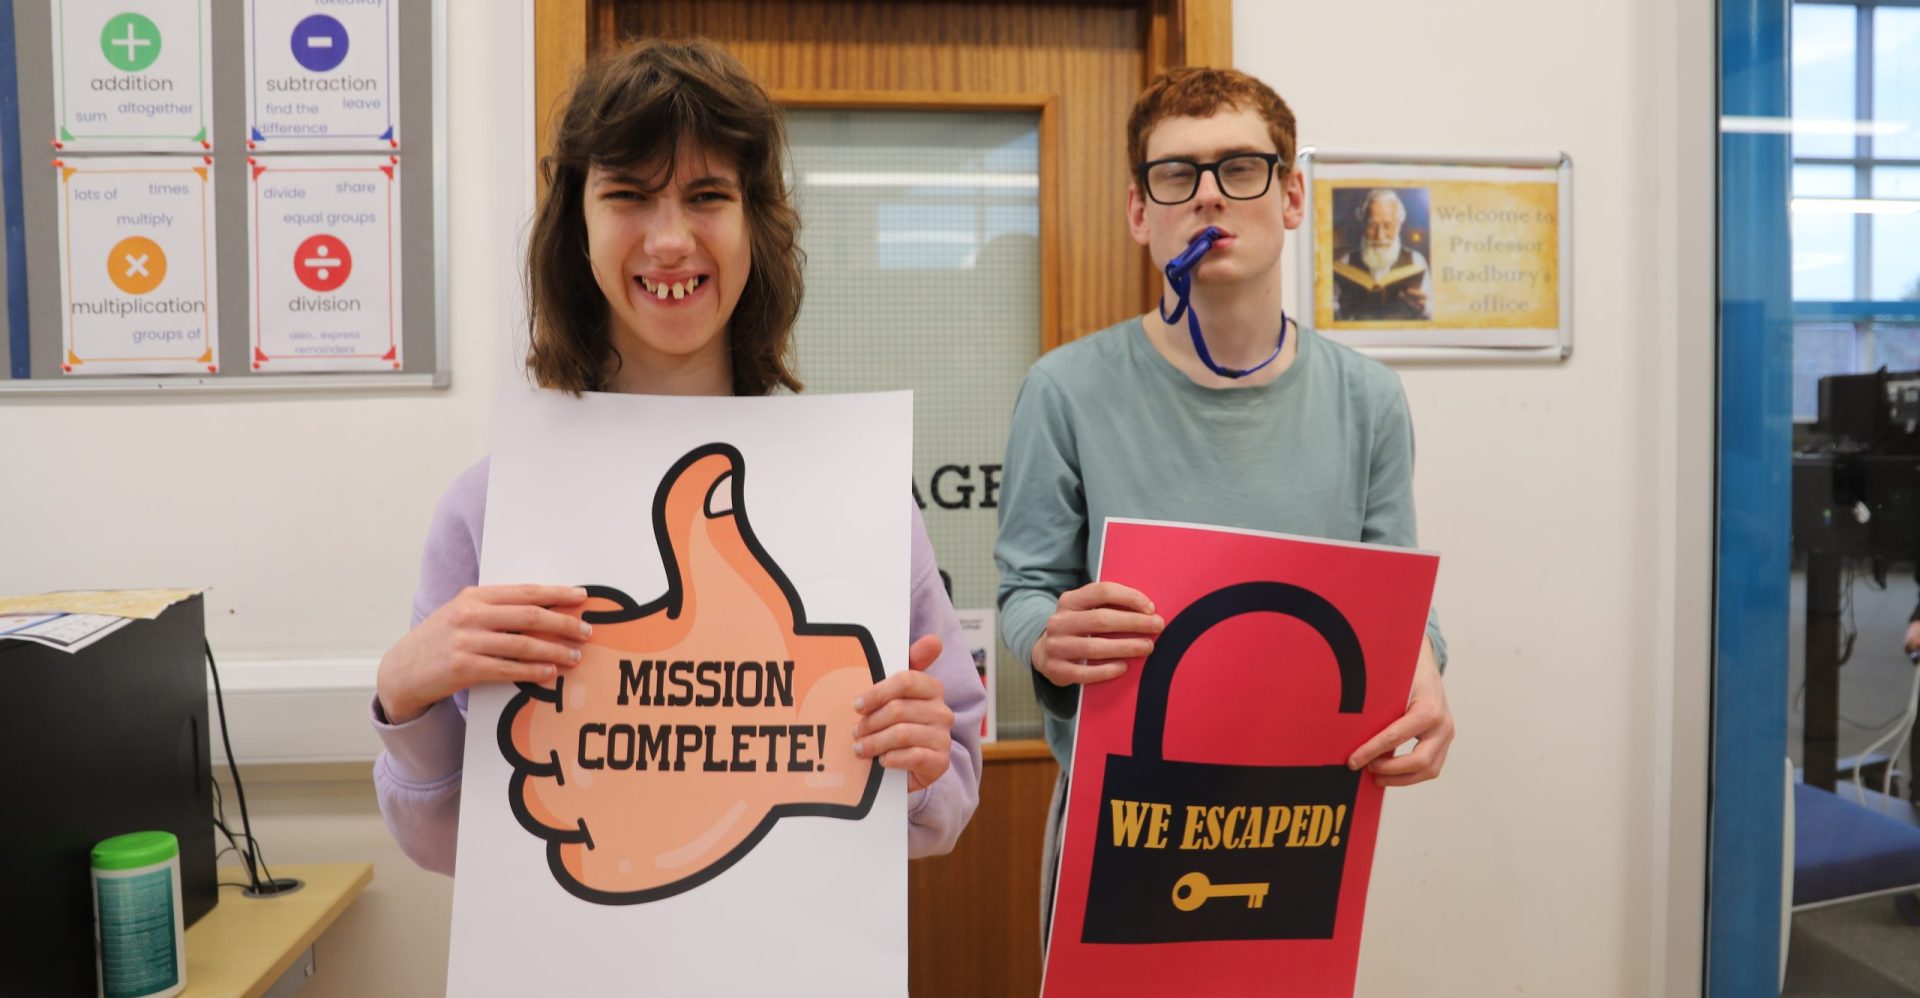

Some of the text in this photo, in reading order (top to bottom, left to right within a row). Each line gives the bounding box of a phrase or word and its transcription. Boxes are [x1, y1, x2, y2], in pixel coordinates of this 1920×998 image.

[90, 75, 174, 92] addition
[266, 75, 377, 92] subtraction
[117, 101, 193, 117] altogether
[265, 102, 319, 115] find the
[342, 98, 381, 110] leave
[75, 111, 108, 123] sum
[259, 122, 328, 135] difference
[74, 188, 118, 201] lots of
[149, 183, 189, 195] times
[263, 186, 306, 200] divide
[335, 181, 376, 194] share
[116, 212, 174, 228] multiply
[283, 211, 376, 227] equal groups
[1436, 204, 1555, 224] Welcome to
[1449, 234, 1544, 253] Professor
[1442, 264, 1553, 290] Bradbury's
[71, 297, 206, 318] multiplication
[288, 296, 361, 312] division
[1469, 293, 1529, 312] office
[132, 327, 202, 344] groups of
[617, 660, 794, 707] MISSION
[578, 723, 826, 772] COMPLETE!
[1110, 799, 1346, 850] WE ESCAPED!
